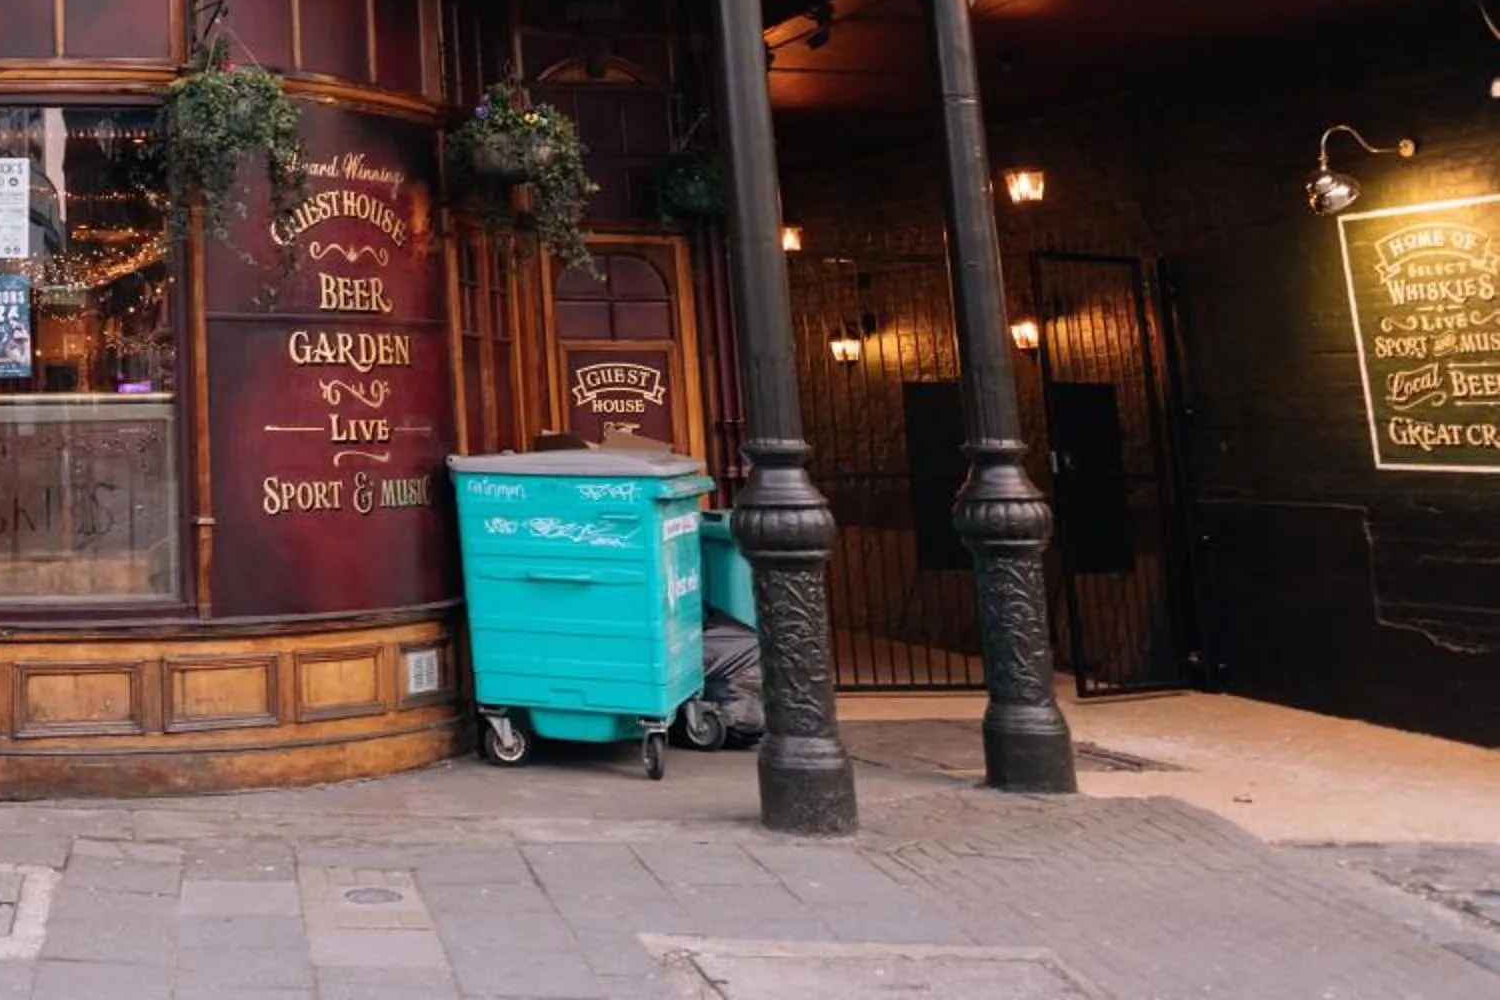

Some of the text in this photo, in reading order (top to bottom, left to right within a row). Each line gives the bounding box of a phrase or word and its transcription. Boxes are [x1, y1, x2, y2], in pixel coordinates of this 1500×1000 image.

[342, 151, 404, 200] Winning
[1389, 230, 1477, 257] HOME OF
[1408, 261, 1467, 278] SELECT
[319, 272, 393, 313] BEER
[1386, 273, 1495, 305] WHISKIES
[1421, 312, 1468, 331] LIVE
[288, 330, 410, 373] GARDEN
[1375, 335, 1427, 358] SPORT
[586, 368, 650, 387] GUEST
[1388, 362, 1500, 402] Local BEE
[592, 399, 645, 413] HOUSE
[330, 413, 390, 442] LIVE
[1389, 416, 1463, 451] GREAT
[263, 471, 430, 516] SPORT & MUSIC
